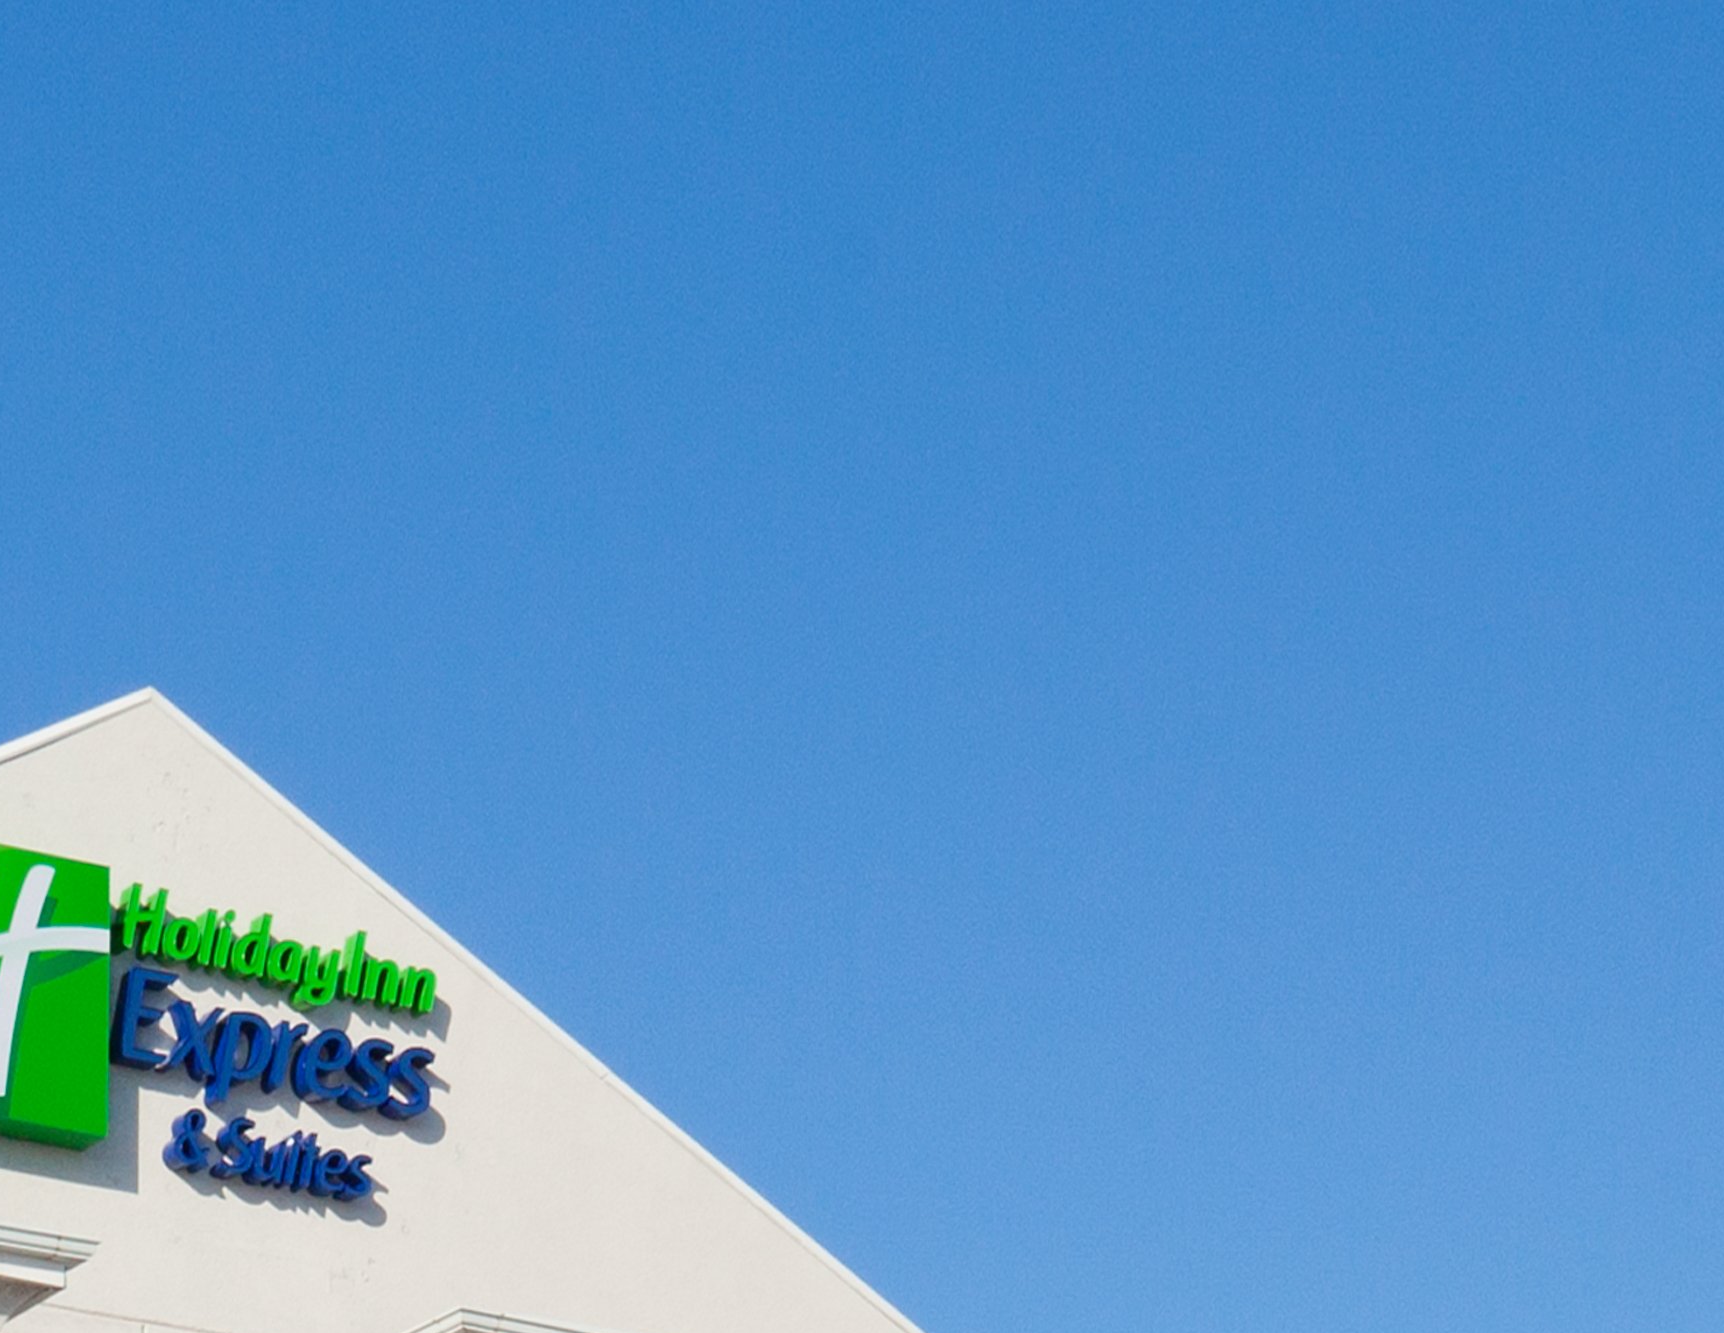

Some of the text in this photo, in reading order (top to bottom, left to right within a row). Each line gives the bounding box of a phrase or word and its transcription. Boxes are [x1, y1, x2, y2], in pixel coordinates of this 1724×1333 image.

[119, 882, 437, 1015] Holiday Inn
[111, 965, 436, 1120] Express
[162, 1108, 374, 1202] & Suites
